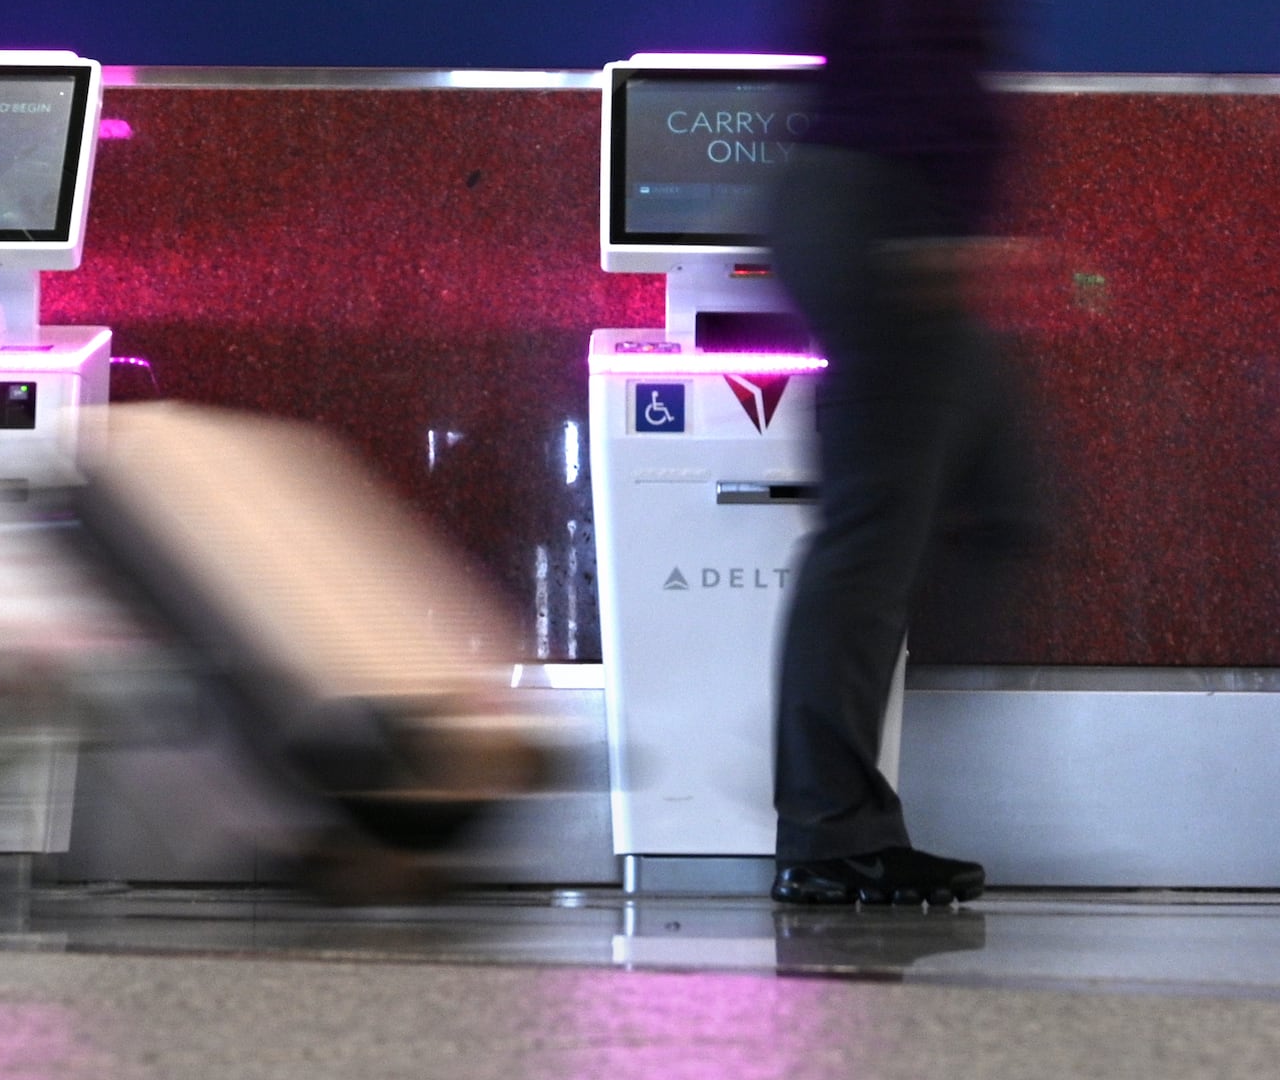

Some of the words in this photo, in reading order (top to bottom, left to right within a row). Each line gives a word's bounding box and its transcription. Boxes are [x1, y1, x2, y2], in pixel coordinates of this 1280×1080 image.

[12, 102, 51, 113] BEGIN
[667, 110, 775, 134] CARRY
[707, 140, 796, 163] ONLY
[701, 568, 790, 588] DELT
